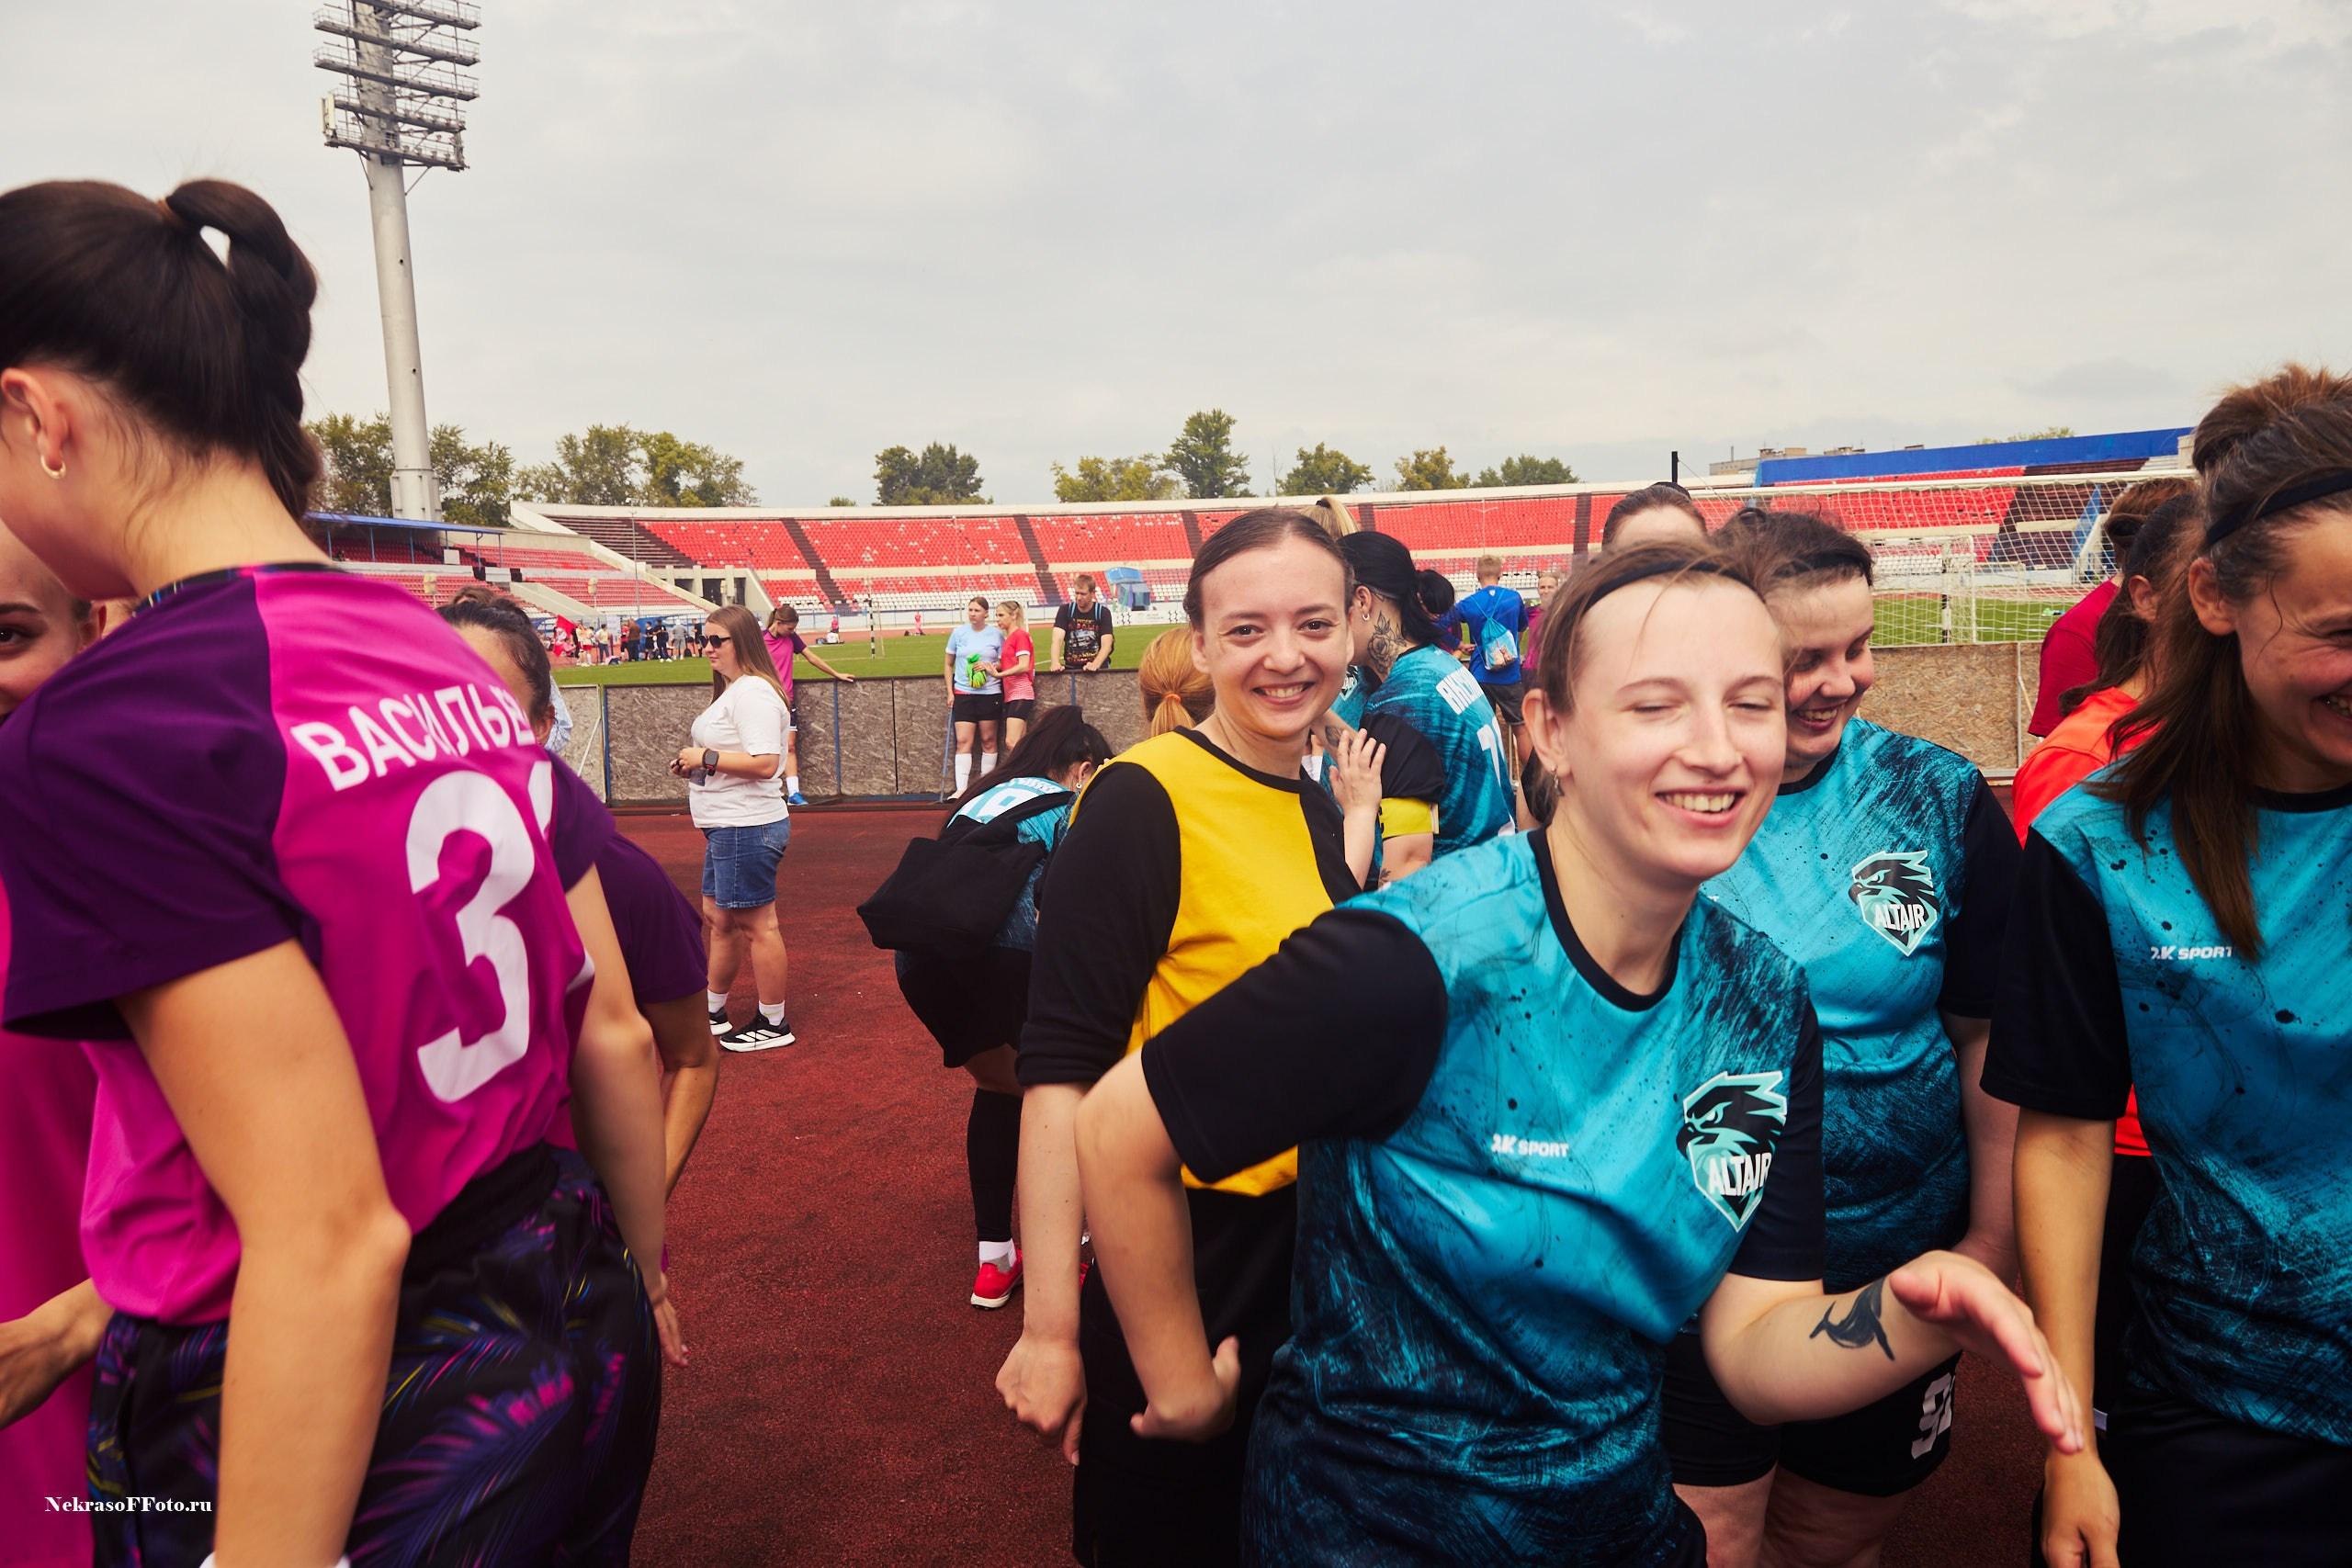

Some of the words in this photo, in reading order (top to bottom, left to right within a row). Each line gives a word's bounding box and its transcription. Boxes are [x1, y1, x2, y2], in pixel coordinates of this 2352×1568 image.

[1874, 903, 1926, 931] ALTAIR
[2177, 945, 2233, 960] SPORT
[1518, 1139, 1569, 1157] SPORT
[1709, 1152, 1773, 1197] ALTAIR
